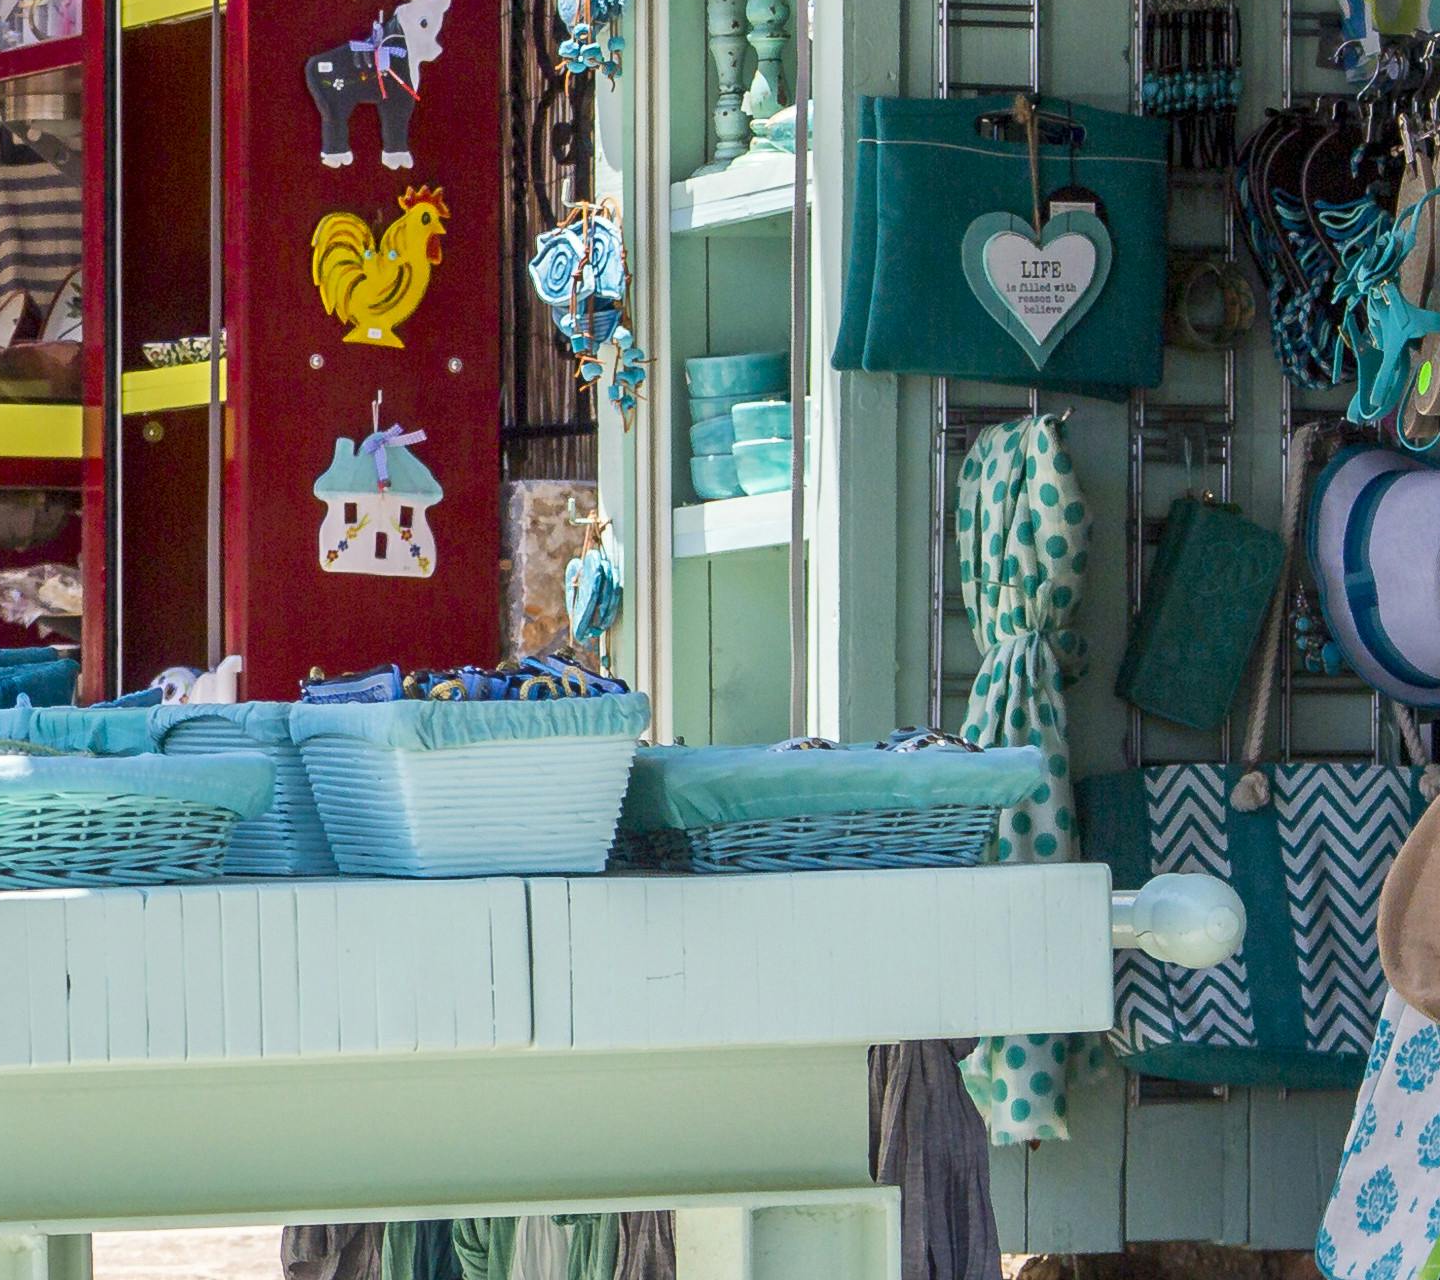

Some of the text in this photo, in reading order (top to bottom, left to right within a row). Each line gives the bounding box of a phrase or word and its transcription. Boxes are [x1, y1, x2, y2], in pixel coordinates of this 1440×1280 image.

[1021, 261, 1062, 279] LIFE
[1006, 282, 1077, 293] is filled with
[1017, 294, 1065, 304] reason to
[1023, 305, 1063, 315] believe
